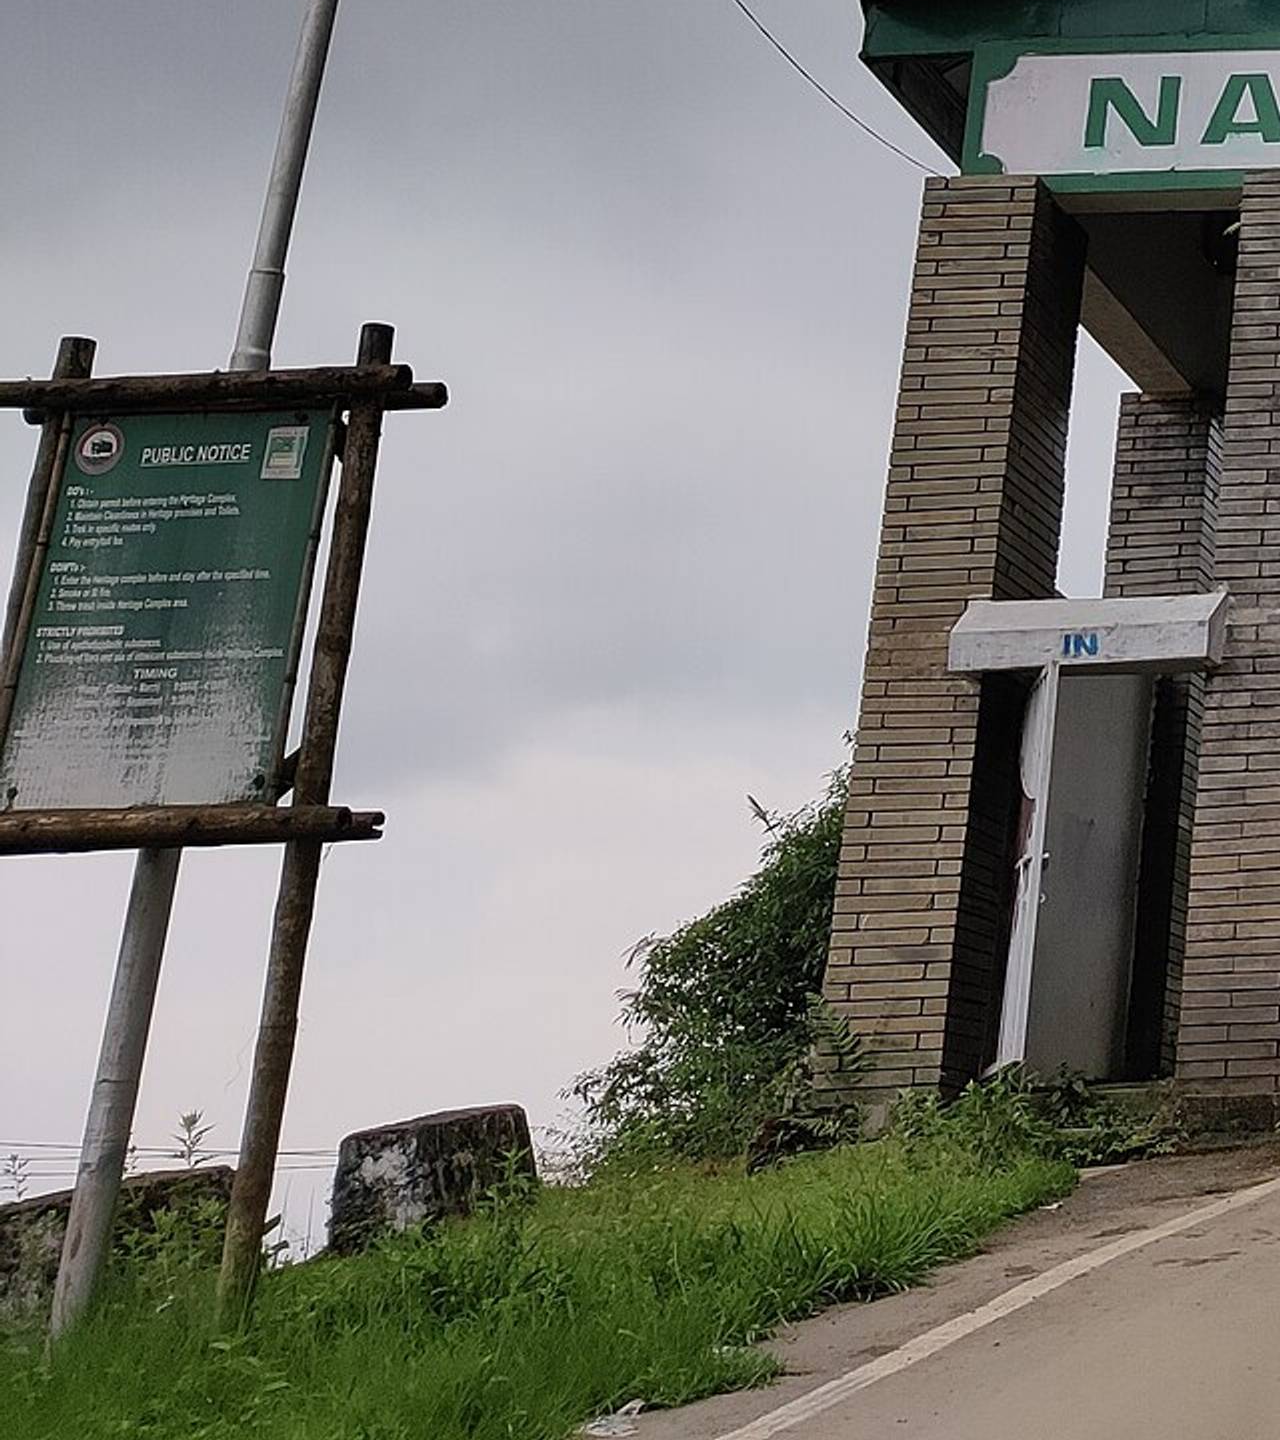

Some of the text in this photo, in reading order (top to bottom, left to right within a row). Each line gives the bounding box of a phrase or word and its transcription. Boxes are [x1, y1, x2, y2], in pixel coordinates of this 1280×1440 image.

[142, 443, 251, 464] PUBLIC NOTICE
[1061, 632, 1100, 657] IN
[133, 667, 178, 680] TIMING
